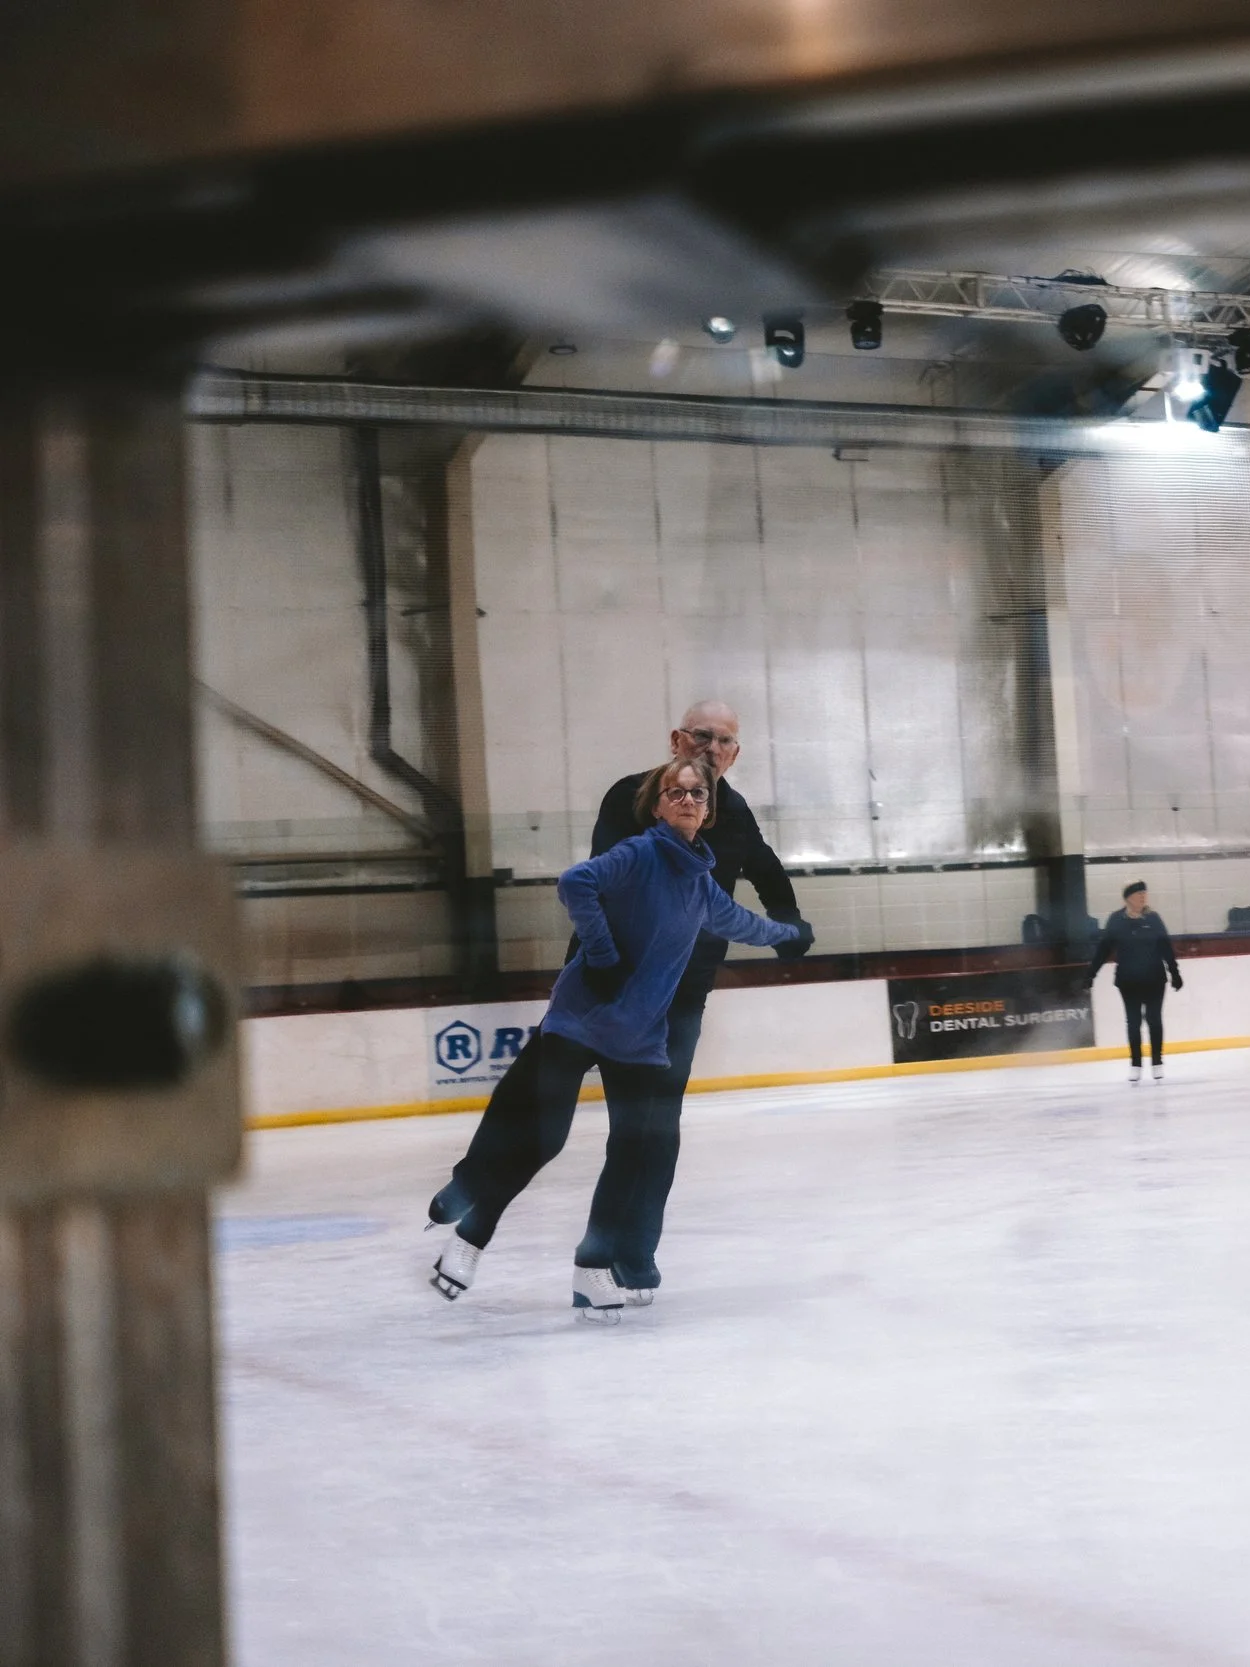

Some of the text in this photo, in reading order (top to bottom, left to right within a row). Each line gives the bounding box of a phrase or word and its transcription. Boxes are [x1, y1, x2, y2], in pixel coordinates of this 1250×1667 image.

[928, 1000, 1005, 1017] DEESIDE
[930, 1007, 1090, 1033] DENTAL SURGERY
[447, 1034, 471, 1060] R
